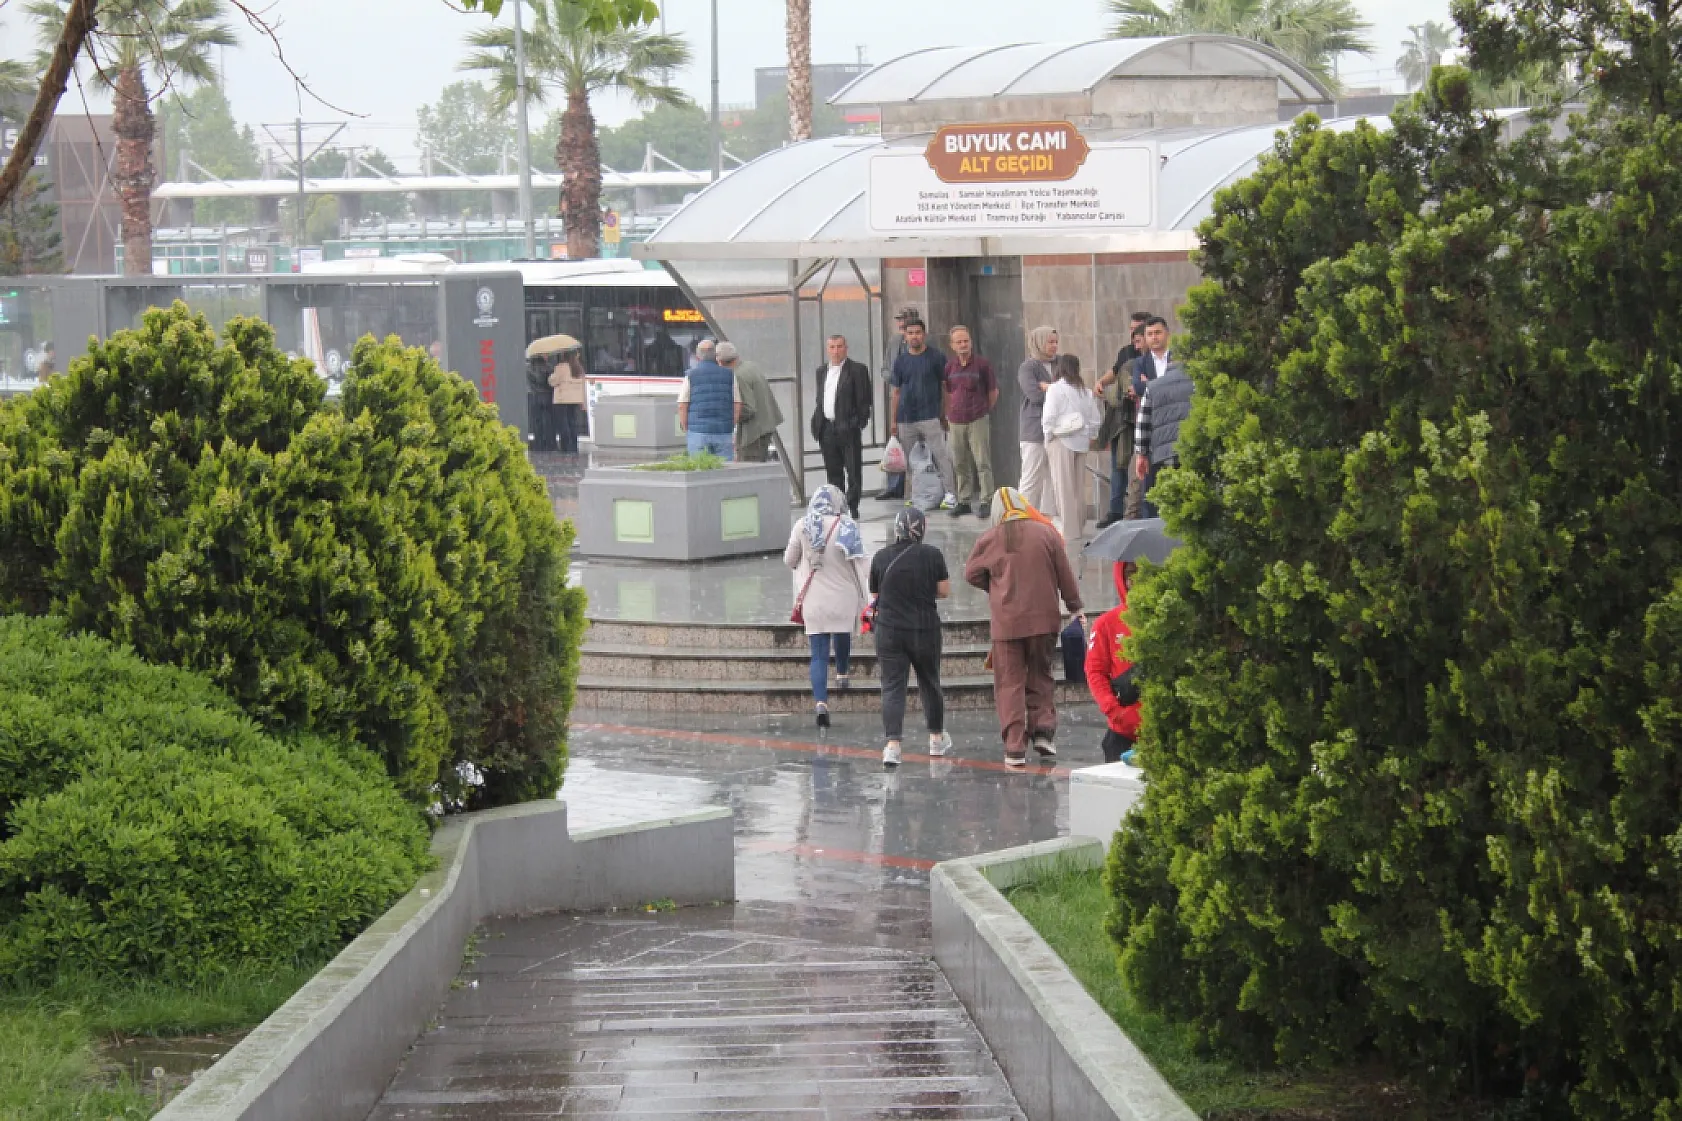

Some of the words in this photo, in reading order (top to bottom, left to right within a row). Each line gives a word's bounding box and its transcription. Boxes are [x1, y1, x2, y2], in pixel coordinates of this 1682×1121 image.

[959, 155, 991, 174] ALT
[1029, 187, 1051, 197] Yolcu
[931, 202, 949, 211] Kent
[982, 201, 1011, 210] Merkezi
[1036, 200, 1068, 209] Transfer
[948, 213, 977, 222] Merkezi
[986, 212, 1019, 222] Tramvay
